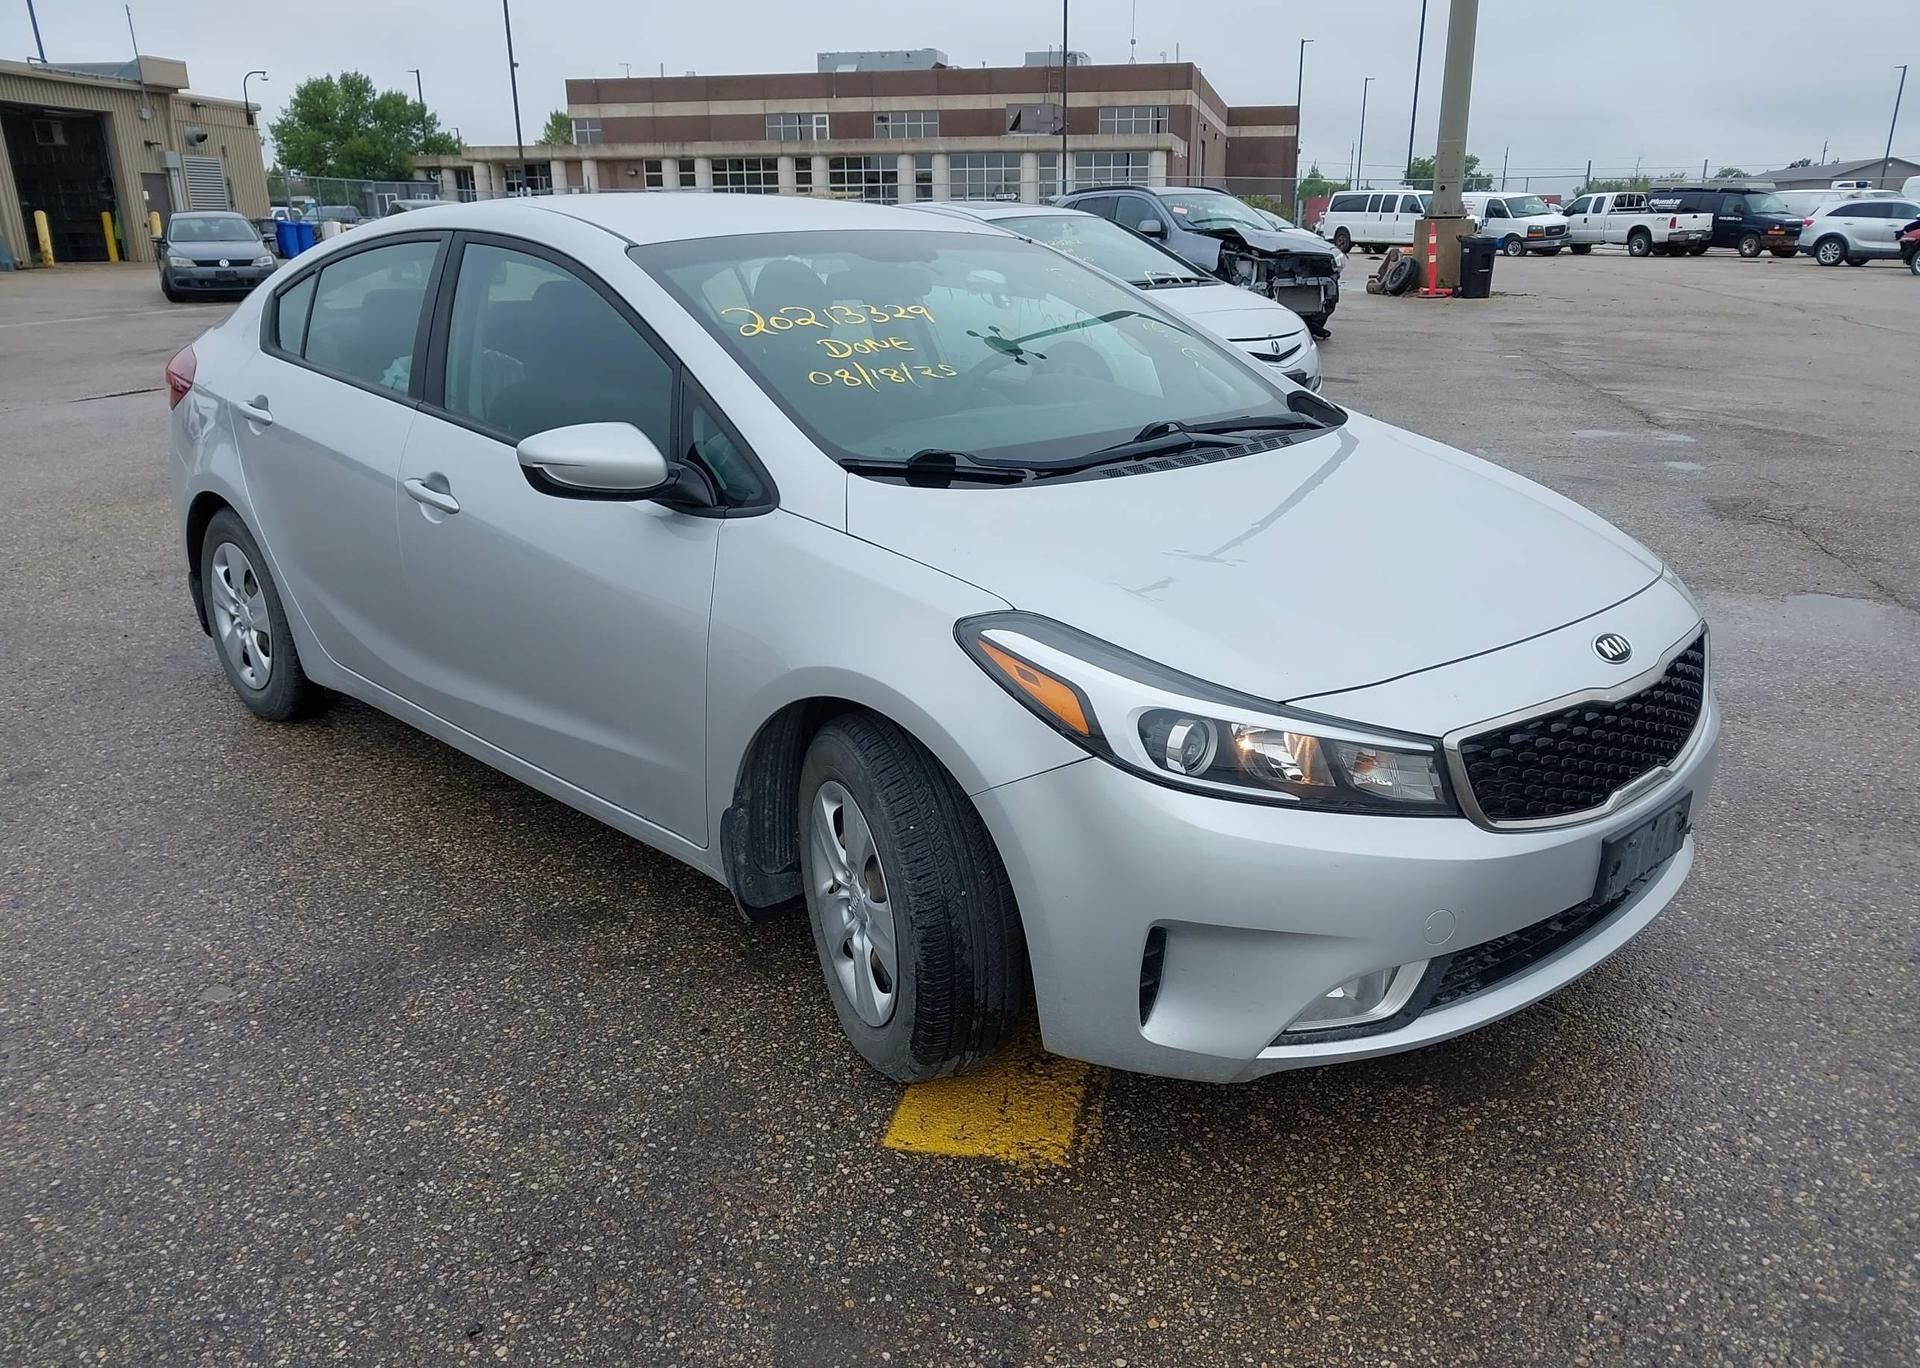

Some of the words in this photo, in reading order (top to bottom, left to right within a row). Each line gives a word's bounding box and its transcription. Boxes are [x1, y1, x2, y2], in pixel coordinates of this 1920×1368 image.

[721, 304, 935, 337] 20213329
[808, 362, 958, 393] 08/18/25
[1597, 635, 1630, 658] KIA
